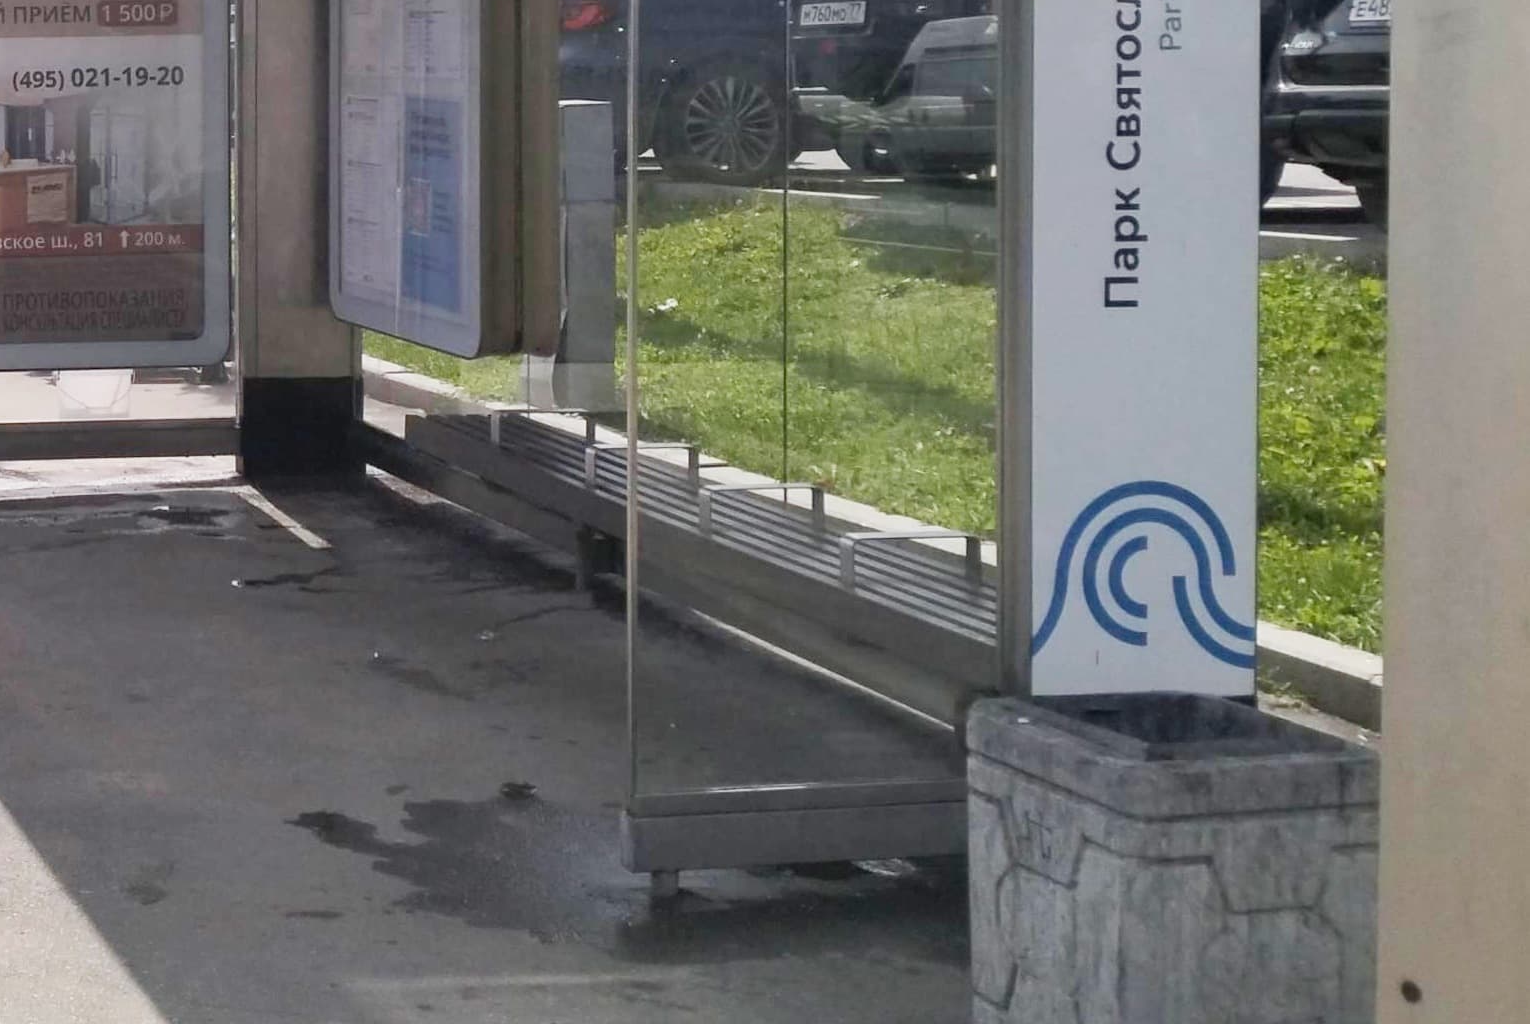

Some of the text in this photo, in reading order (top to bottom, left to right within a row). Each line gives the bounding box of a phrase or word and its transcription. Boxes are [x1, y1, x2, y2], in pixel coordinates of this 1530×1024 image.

[12, 66, 184, 92] (495) 021-19-20
[50, 235, 78, 250] ш.,
[83, 231, 104, 248] 81
[134, 231, 164, 247] 200
[1104, 187, 1148, 307] Парк
